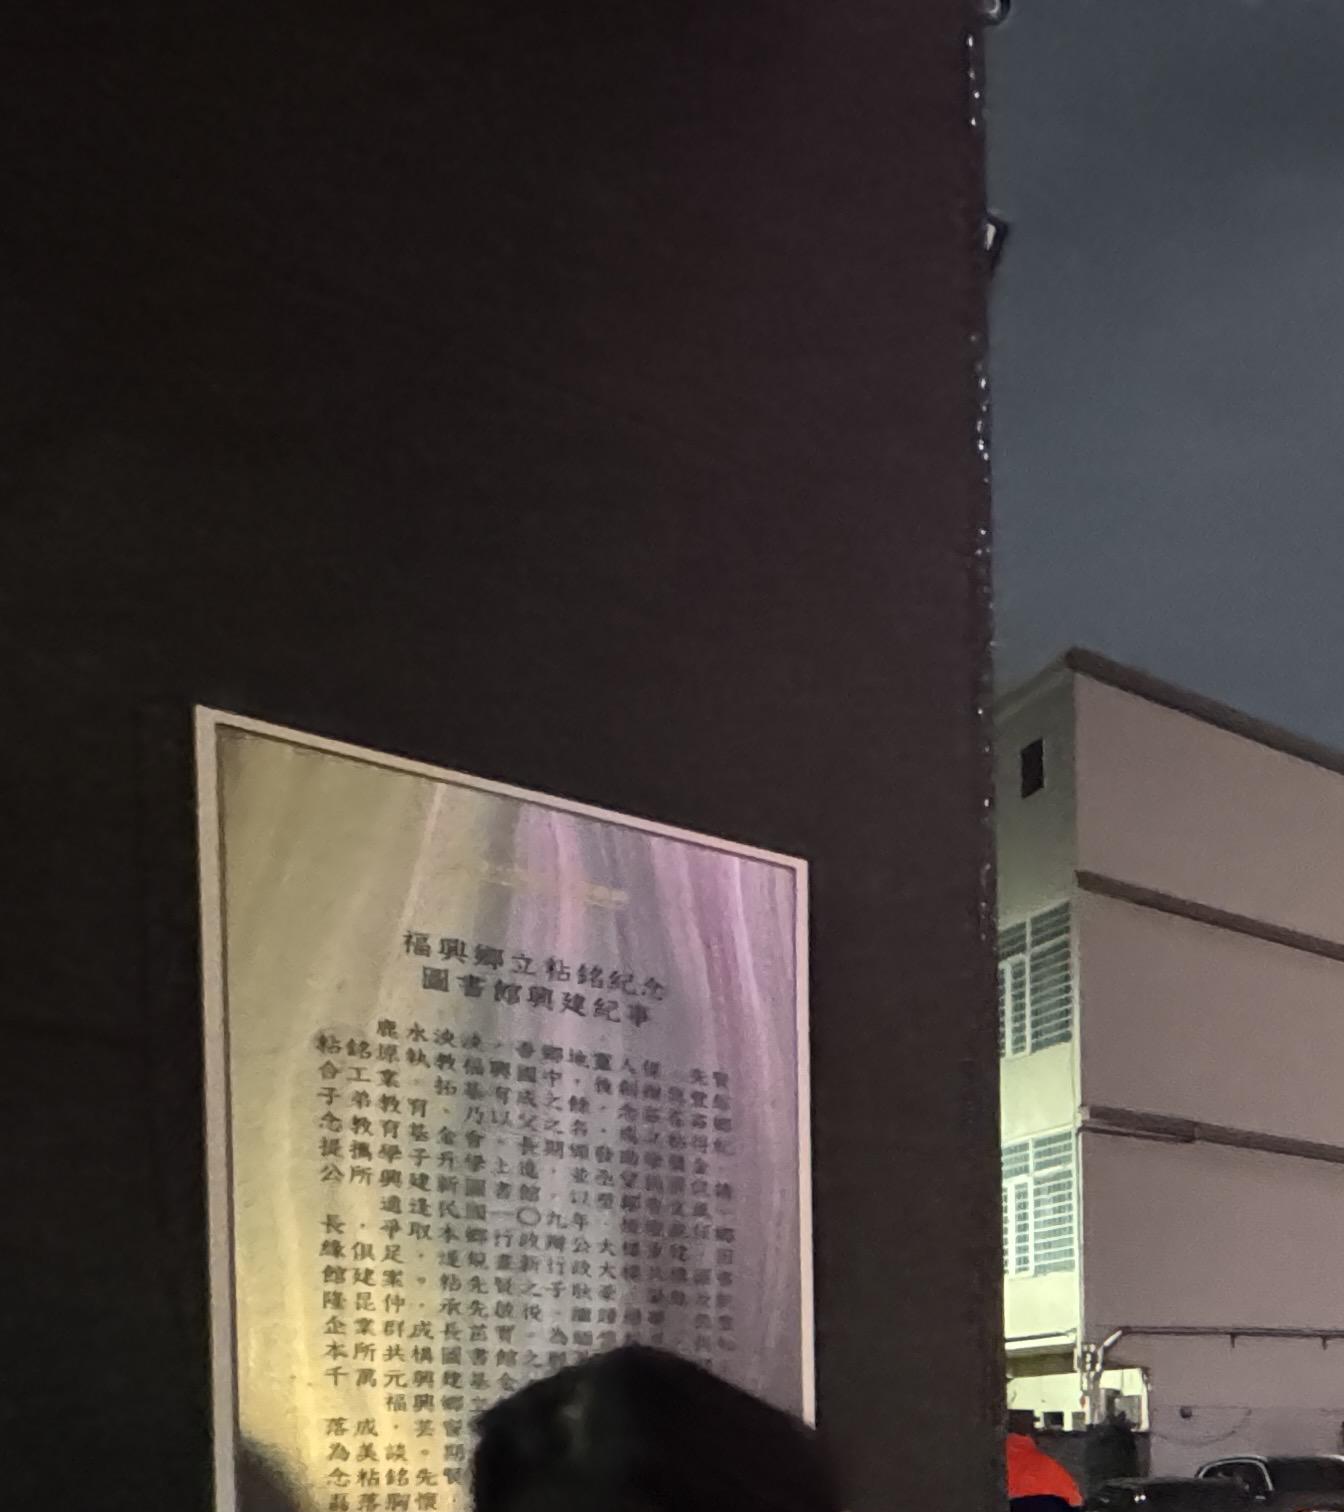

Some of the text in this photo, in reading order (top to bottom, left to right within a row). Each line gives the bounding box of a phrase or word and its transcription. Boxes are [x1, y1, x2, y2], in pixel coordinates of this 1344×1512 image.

[403, 930, 664, 1002] 福興鄉立粘銘紀念
[422, 964, 650, 1029] 圖書館興建紀事
